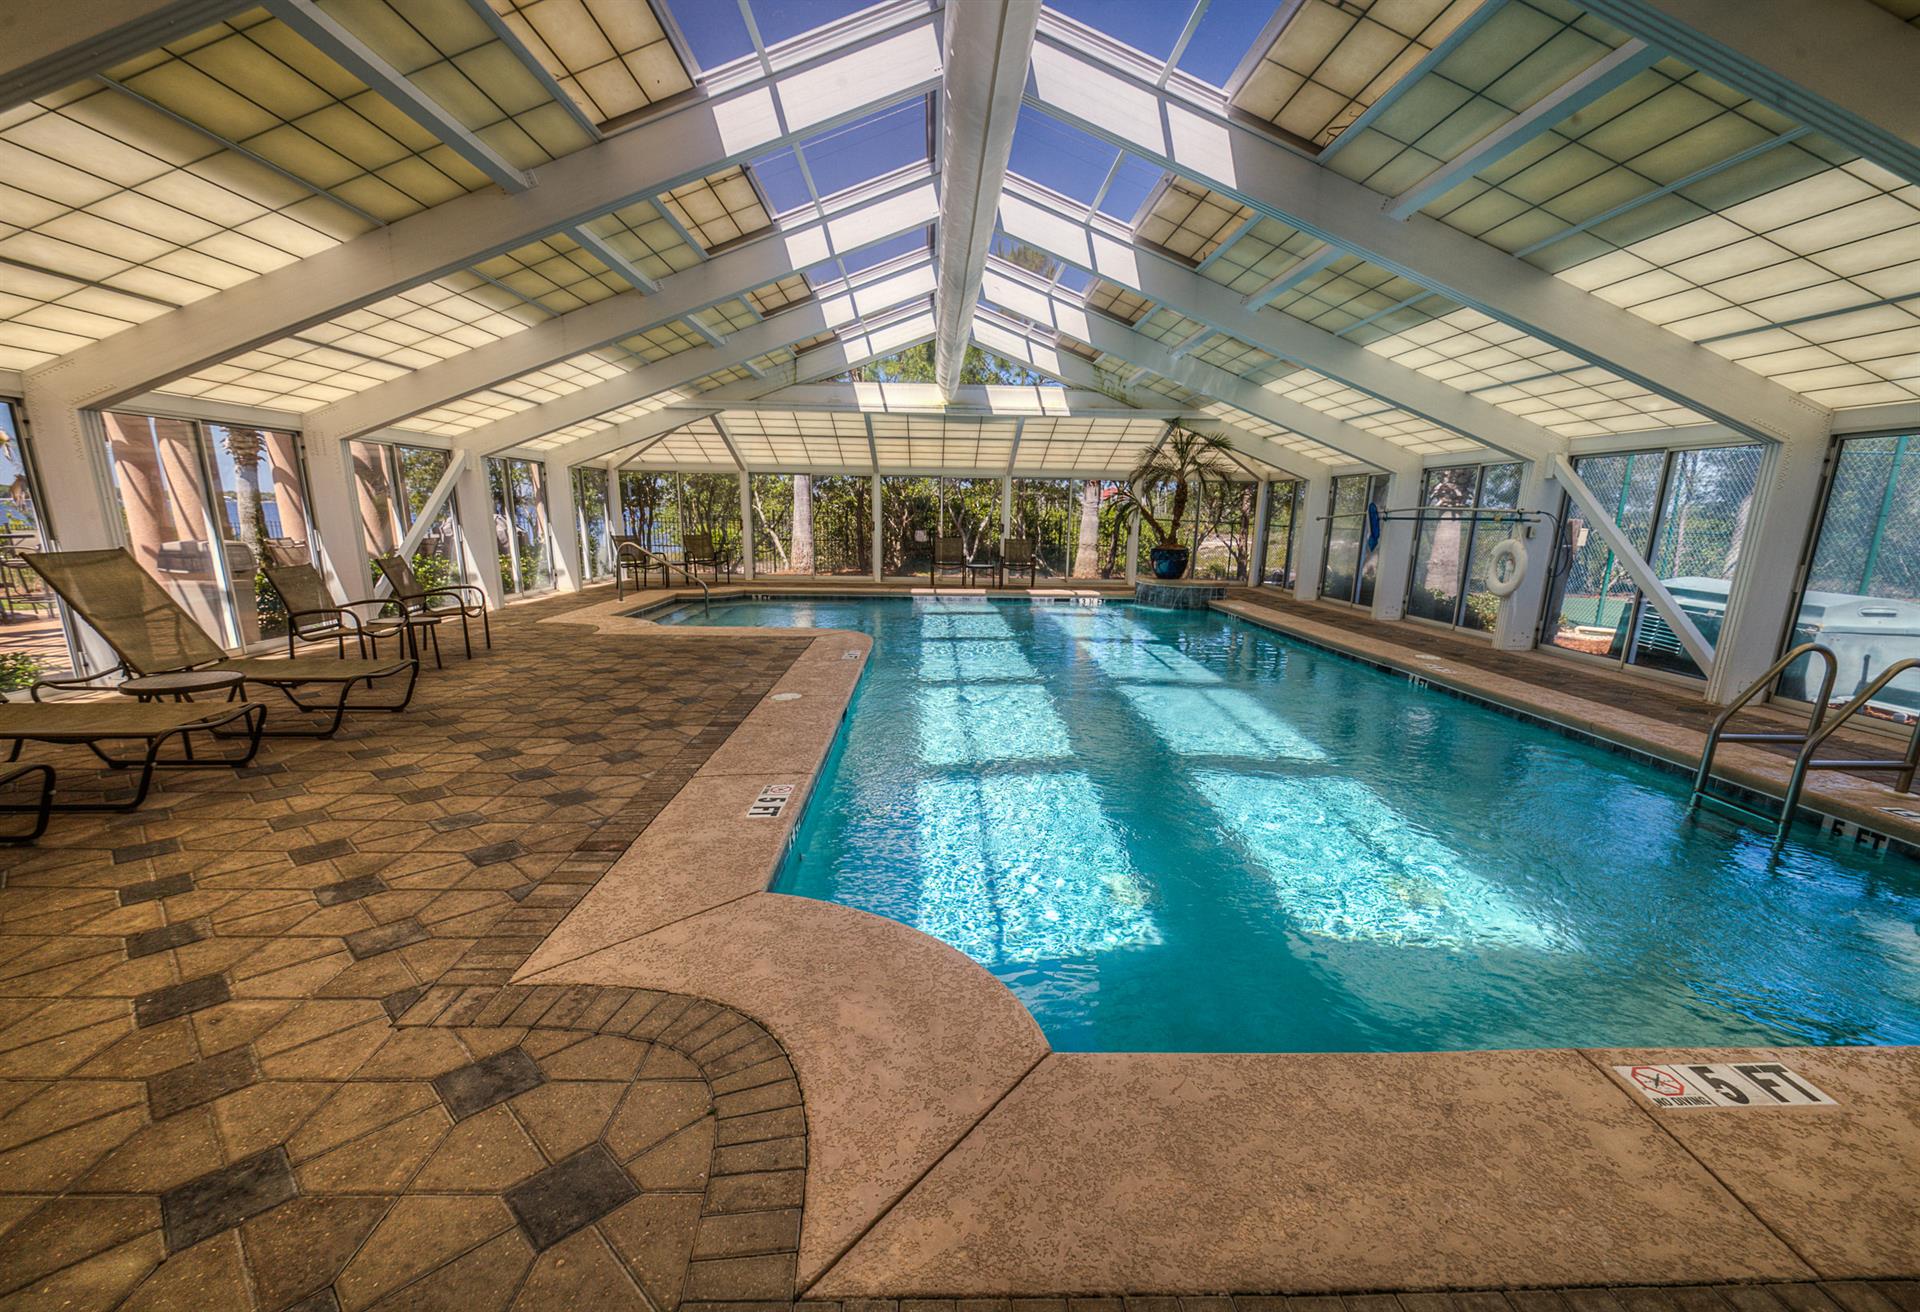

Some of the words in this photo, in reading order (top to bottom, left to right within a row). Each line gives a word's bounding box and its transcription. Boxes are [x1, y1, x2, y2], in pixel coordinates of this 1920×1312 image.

[749, 806, 781, 816] FT
[1856, 827, 1887, 849] FT
[1687, 1065, 1750, 1105] 5
[1733, 1064, 1822, 1104] FT
[1654, 1097, 1673, 1107] NO
[1675, 1096, 1713, 1106] DIVING
